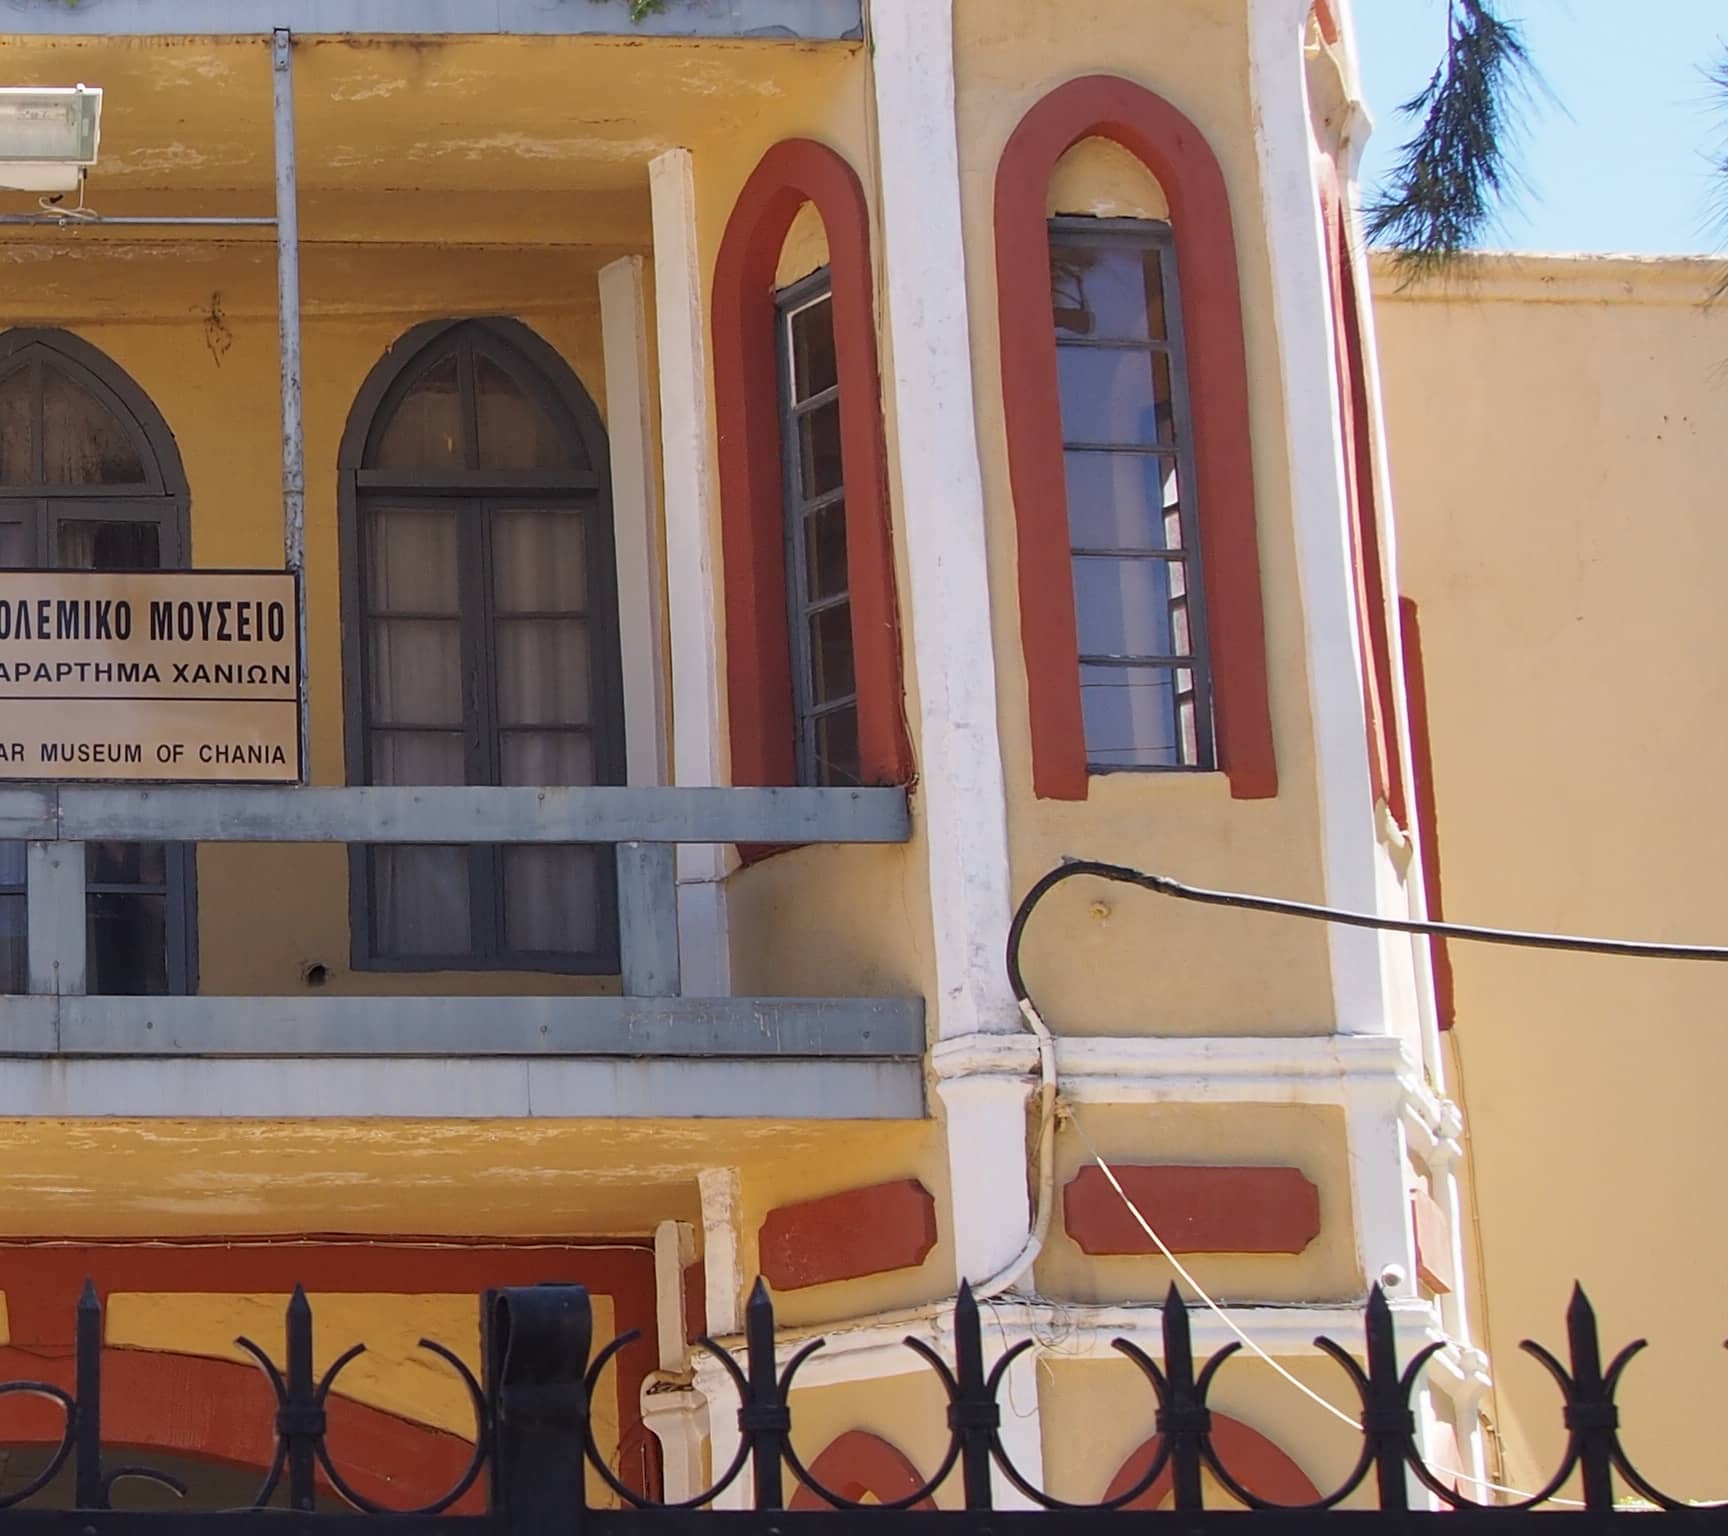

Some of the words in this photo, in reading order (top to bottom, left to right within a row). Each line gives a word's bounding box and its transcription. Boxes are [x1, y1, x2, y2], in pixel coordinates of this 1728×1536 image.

[150, 601, 285, 642] ΜΟΥΣΕΙΟ
[172, 663, 291, 685] ΧΑΝΙΩΝ
[40, 743, 142, 763] MUSEUM
[156, 744, 184, 763] OF
[199, 744, 286, 765] CHANIA
